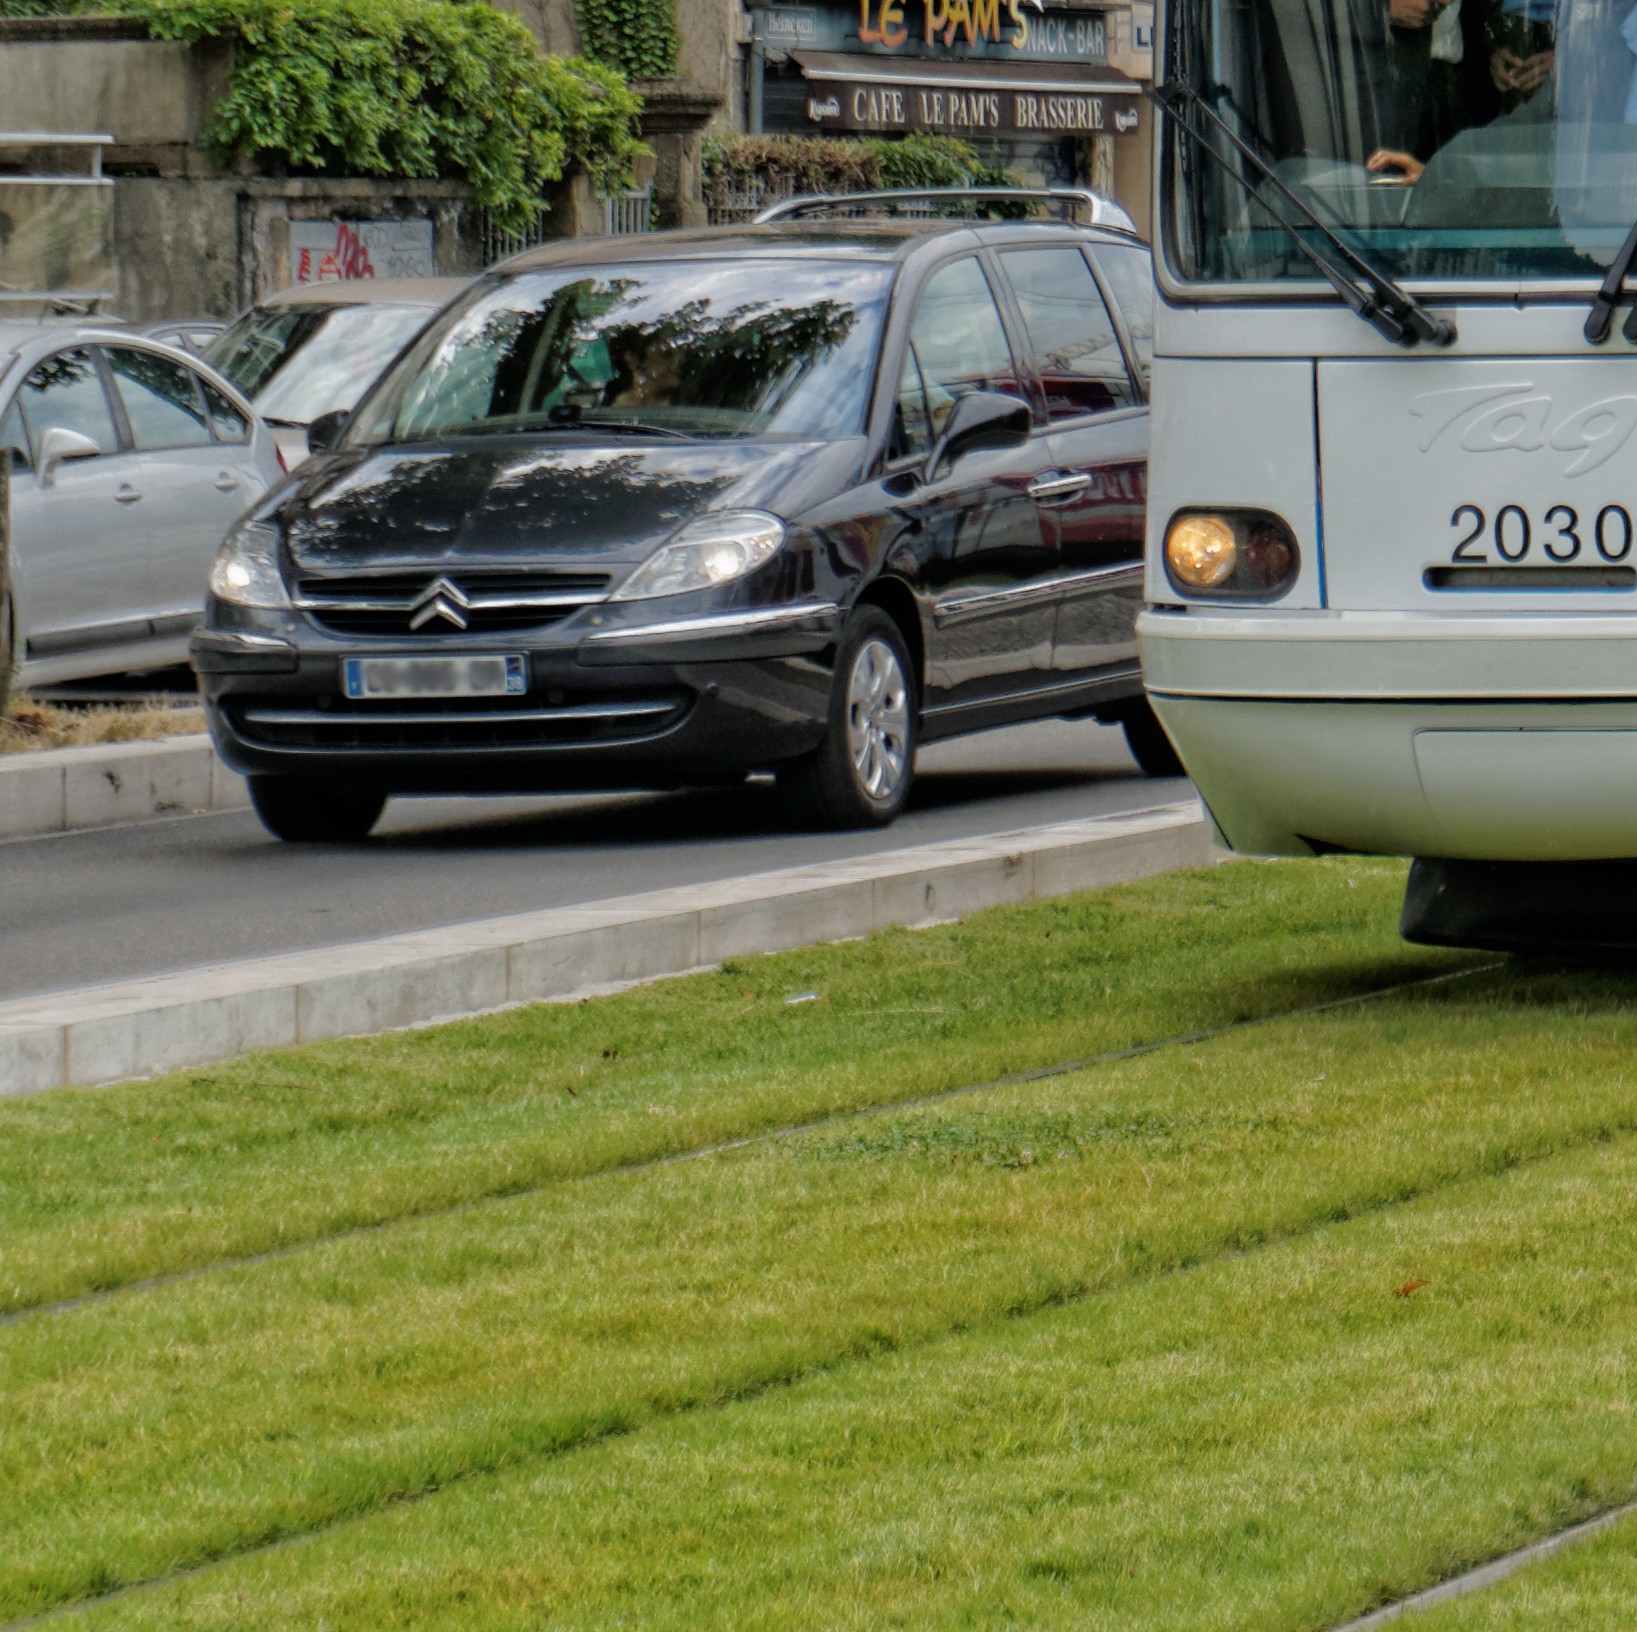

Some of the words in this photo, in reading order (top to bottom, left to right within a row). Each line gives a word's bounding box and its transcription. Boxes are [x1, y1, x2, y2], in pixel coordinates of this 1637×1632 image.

[853, 87, 906, 125] CAFE
[920, 90, 945, 126] LE
[949, 92, 999, 128] PAM'S
[1015, 96, 1105, 130] BRASSERIE
[1450, 503, 1634, 565] 2030
